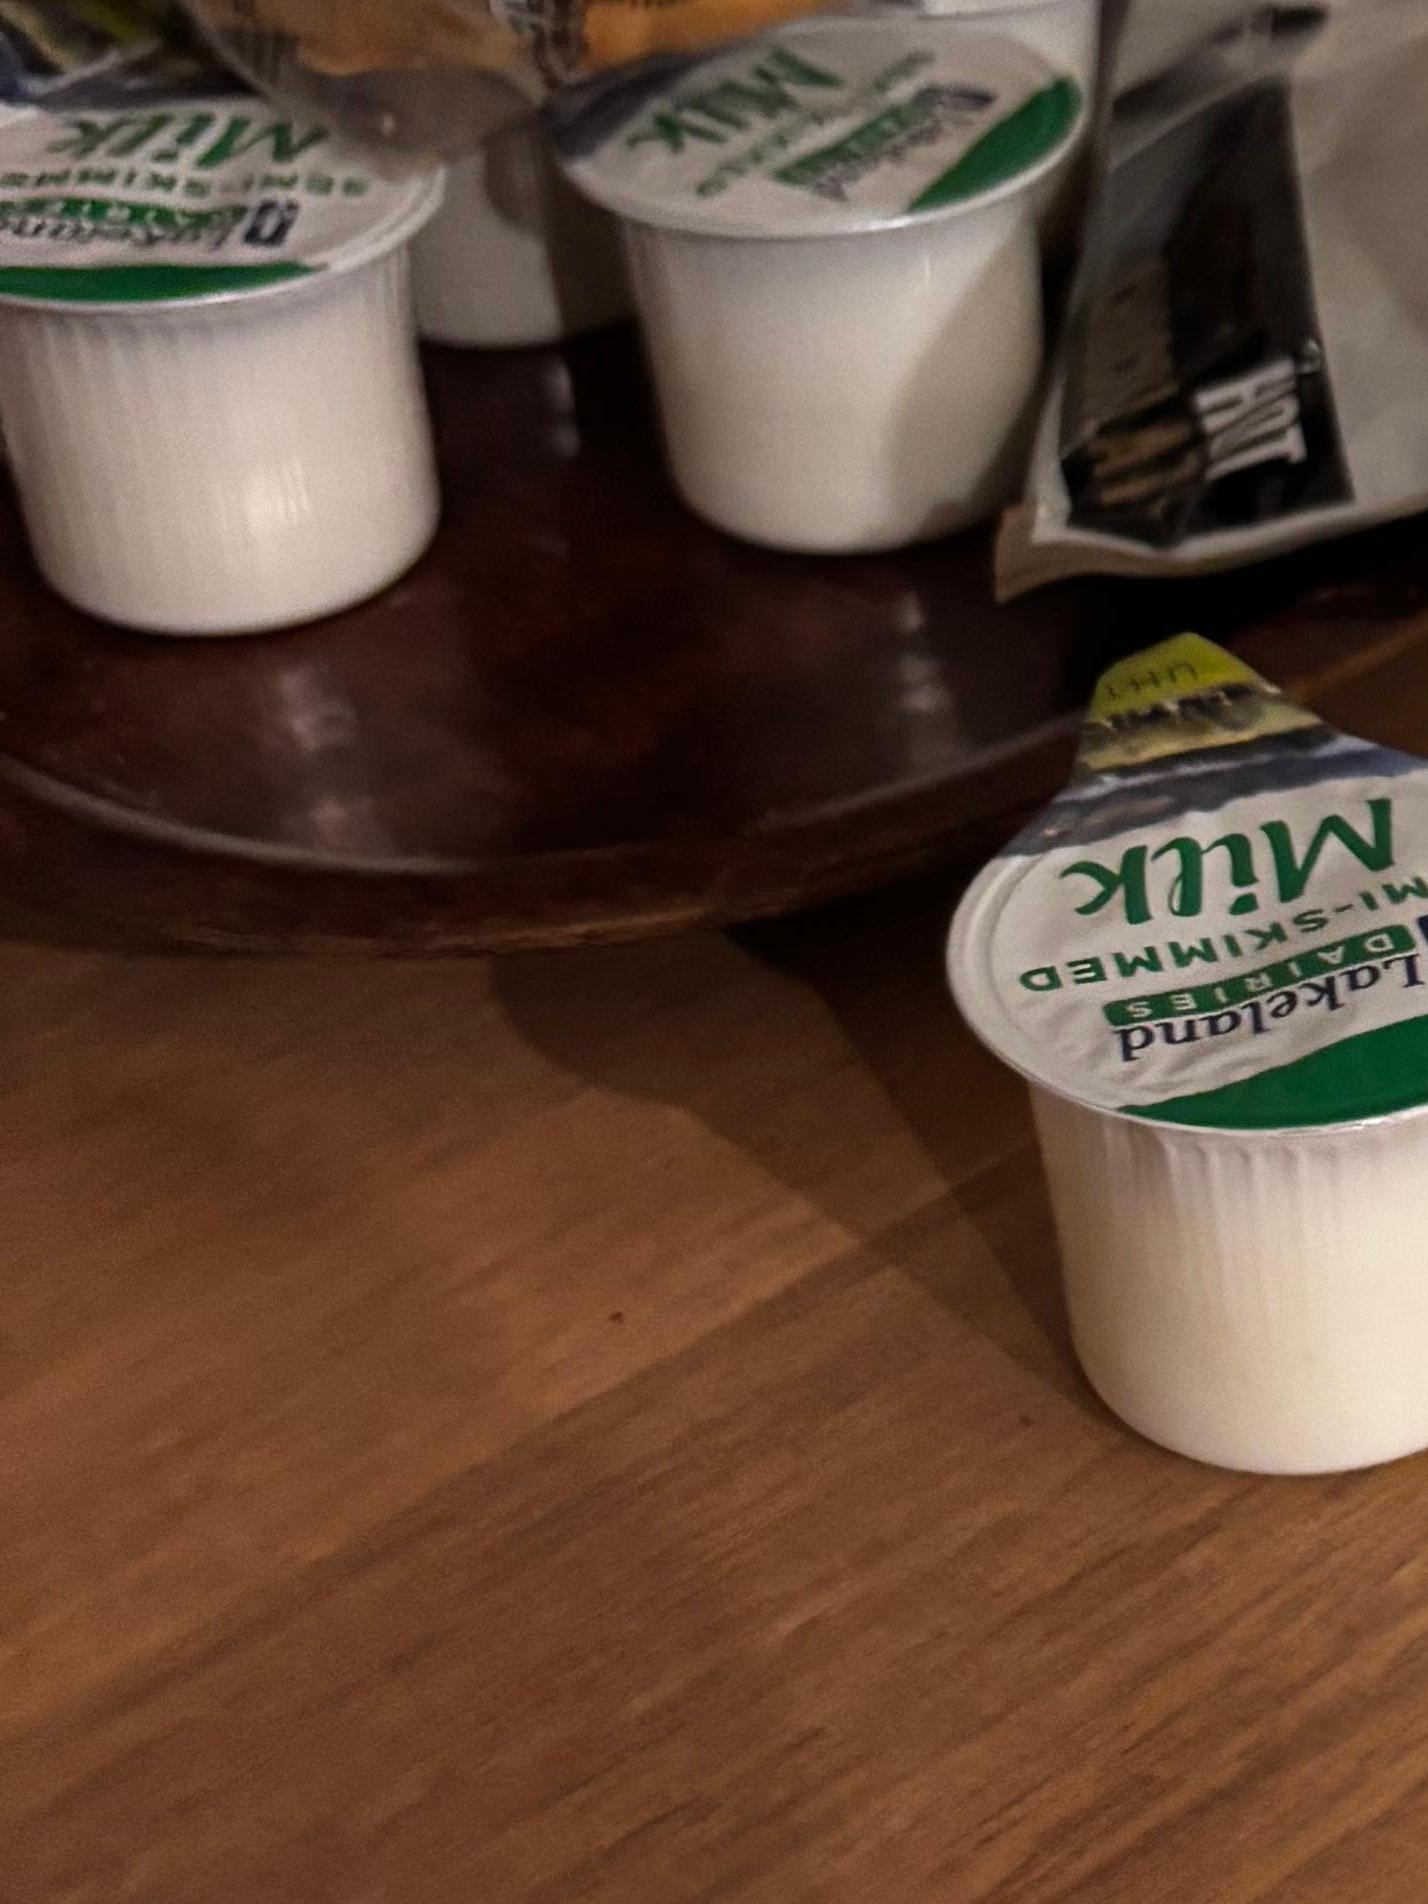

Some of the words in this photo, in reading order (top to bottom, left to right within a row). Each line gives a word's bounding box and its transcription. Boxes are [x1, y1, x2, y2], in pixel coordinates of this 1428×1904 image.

[1059, 797, 1397, 926] Milk
[1112, 954, 1426, 1064] Lakeland
[1128, 934, 1396, 1020] DAIRIES
